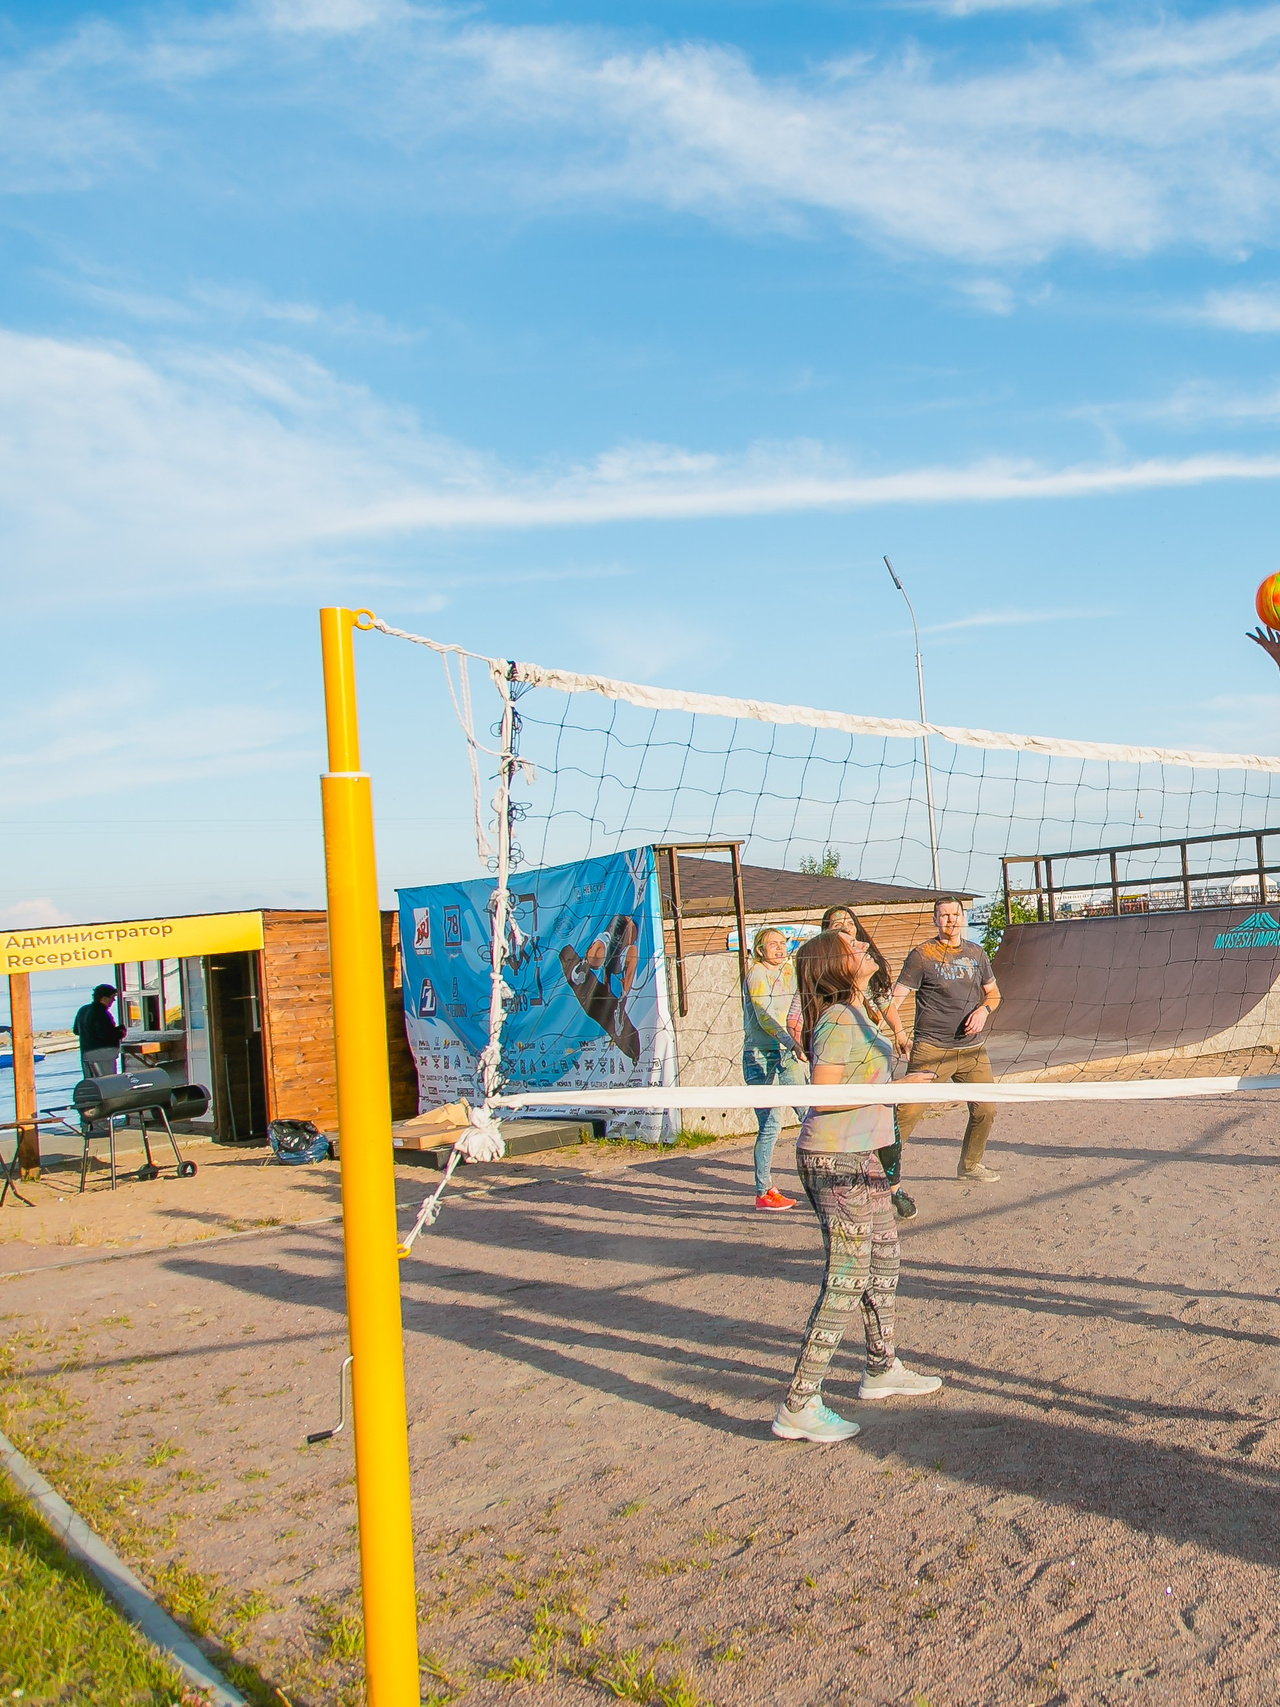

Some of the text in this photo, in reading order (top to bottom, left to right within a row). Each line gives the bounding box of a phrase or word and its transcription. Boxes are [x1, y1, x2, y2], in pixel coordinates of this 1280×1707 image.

[5, 924, 173, 949] Администратор
[447, 914, 458, 938] 78
[7, 947, 113, 968] Reception
